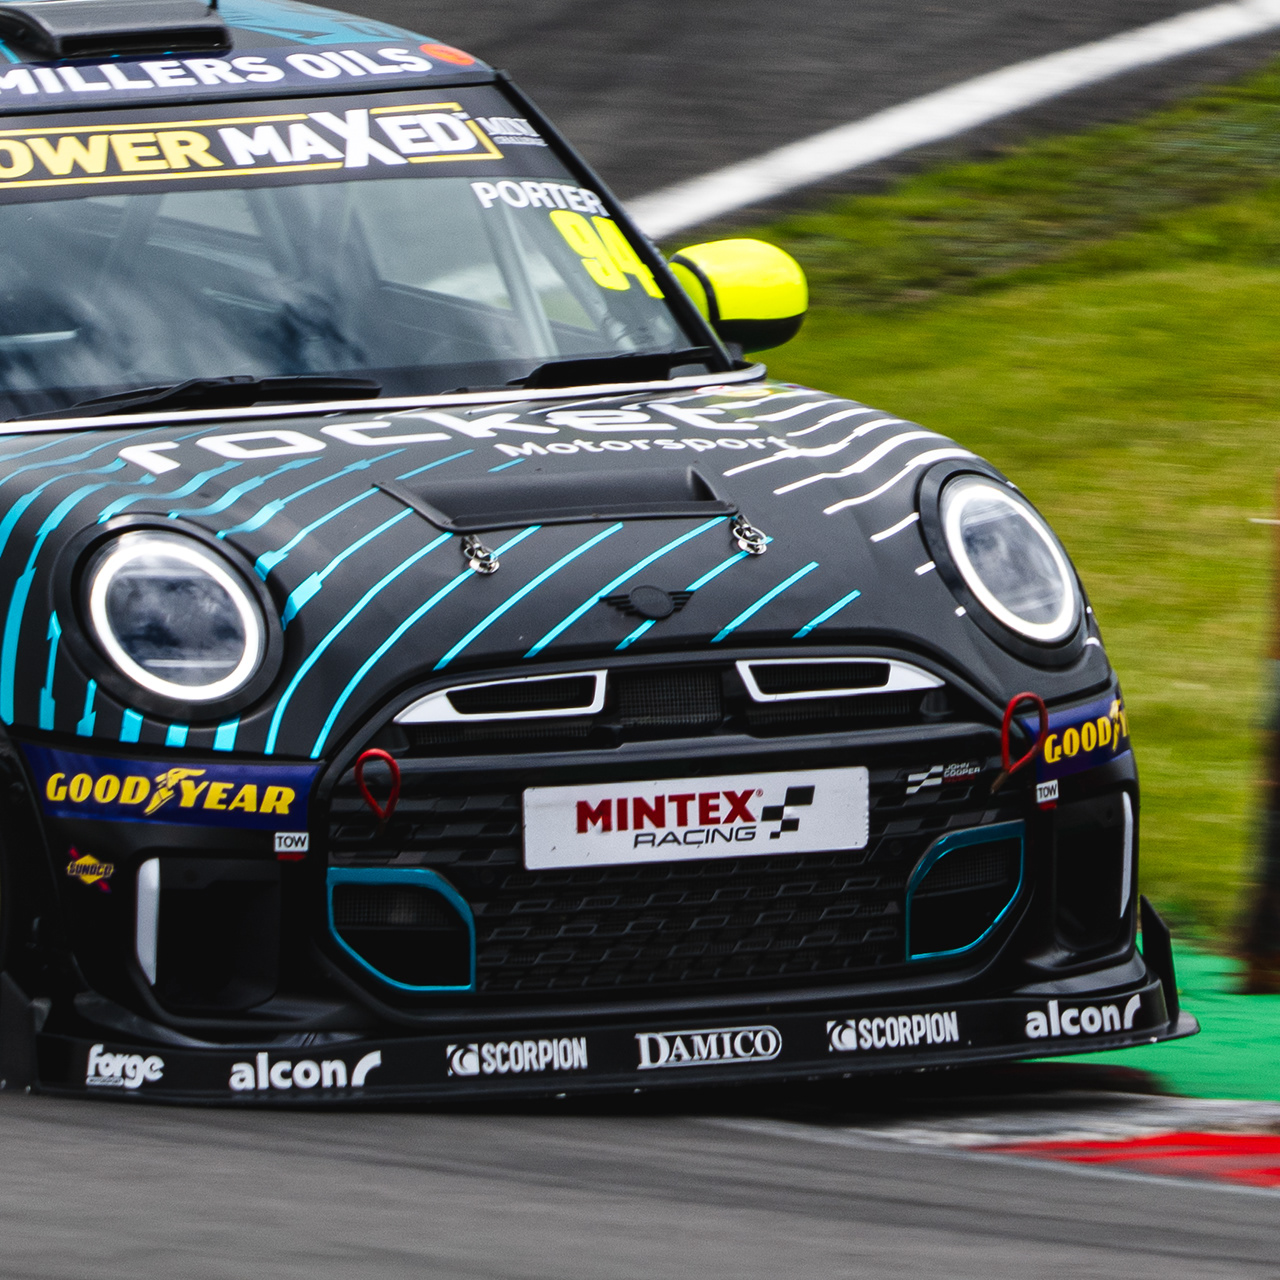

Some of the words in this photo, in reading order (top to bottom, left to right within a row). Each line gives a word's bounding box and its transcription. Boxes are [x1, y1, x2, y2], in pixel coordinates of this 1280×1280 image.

[285, 47, 433, 80] OILS
[218, 108, 479, 168] MAXED
[470, 180, 611, 217] PORTER
[549, 210, 665, 299] 94
[119, 403, 761, 474] rocket
[493, 435, 798, 458] Motorsport
[943, 766, 981, 778] COOPER
[945, 762, 970, 771] JOHN
[46, 767, 296, 815] GOODYEAR
[1038, 783, 1057, 799] TOW
[576, 789, 758, 834] MINTEX
[277, 835, 308, 849] TOW
[633, 825, 758, 849] RACING
[69, 862, 114, 877] SUNOCO
[858, 1010, 960, 1050] SCORPION
[1025, 999, 1122, 1039] alcon
[86, 1043, 165, 1089] forge
[482, 1036, 588, 1074] SCORPION
[635, 1027, 778, 1070] DAMICO
[228, 1051, 348, 1091] alcon
